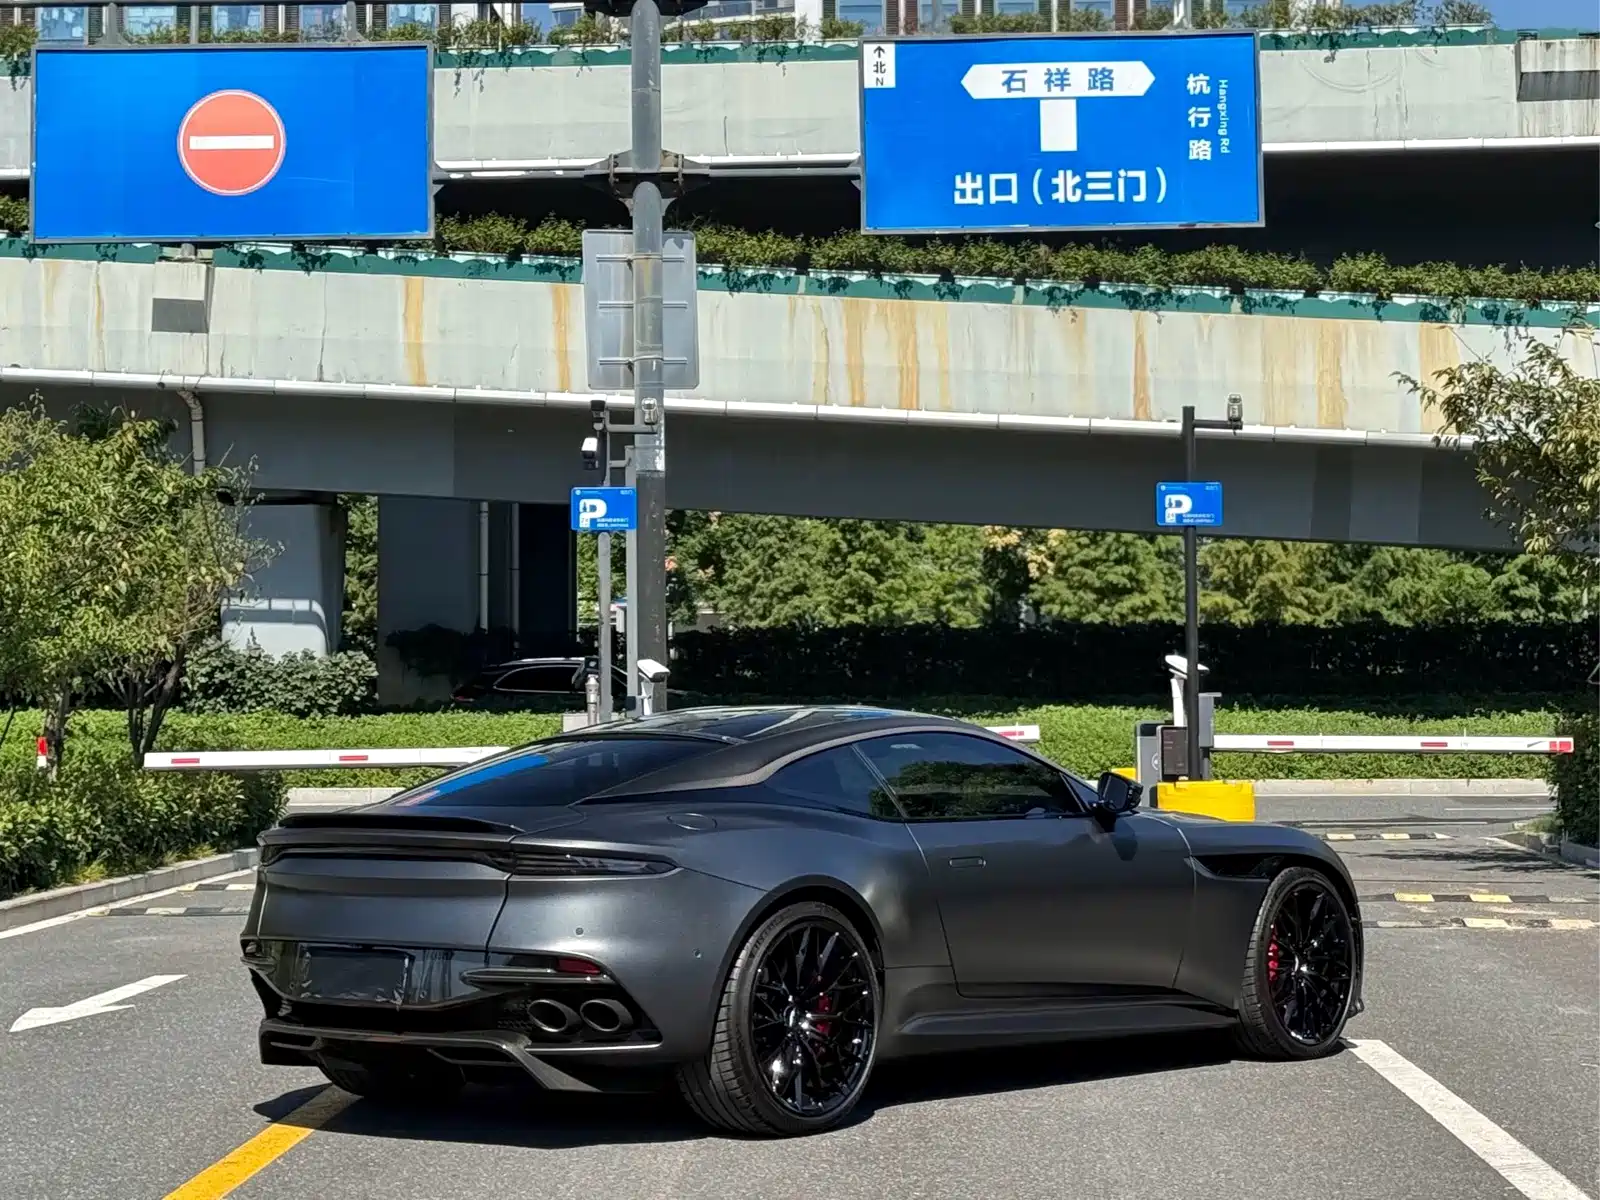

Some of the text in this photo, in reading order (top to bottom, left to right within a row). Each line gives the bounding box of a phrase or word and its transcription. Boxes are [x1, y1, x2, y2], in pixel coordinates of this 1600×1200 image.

[873, 61, 887, 74] 北
[875, 77, 884, 86] N
[1001, 67, 1115, 93] 石祥路
[1187, 73, 1212, 160] 杭行路
[1217, 79, 1231, 154] Hangxing Rd
[953, 166, 1167, 205] 出口（北三门）
